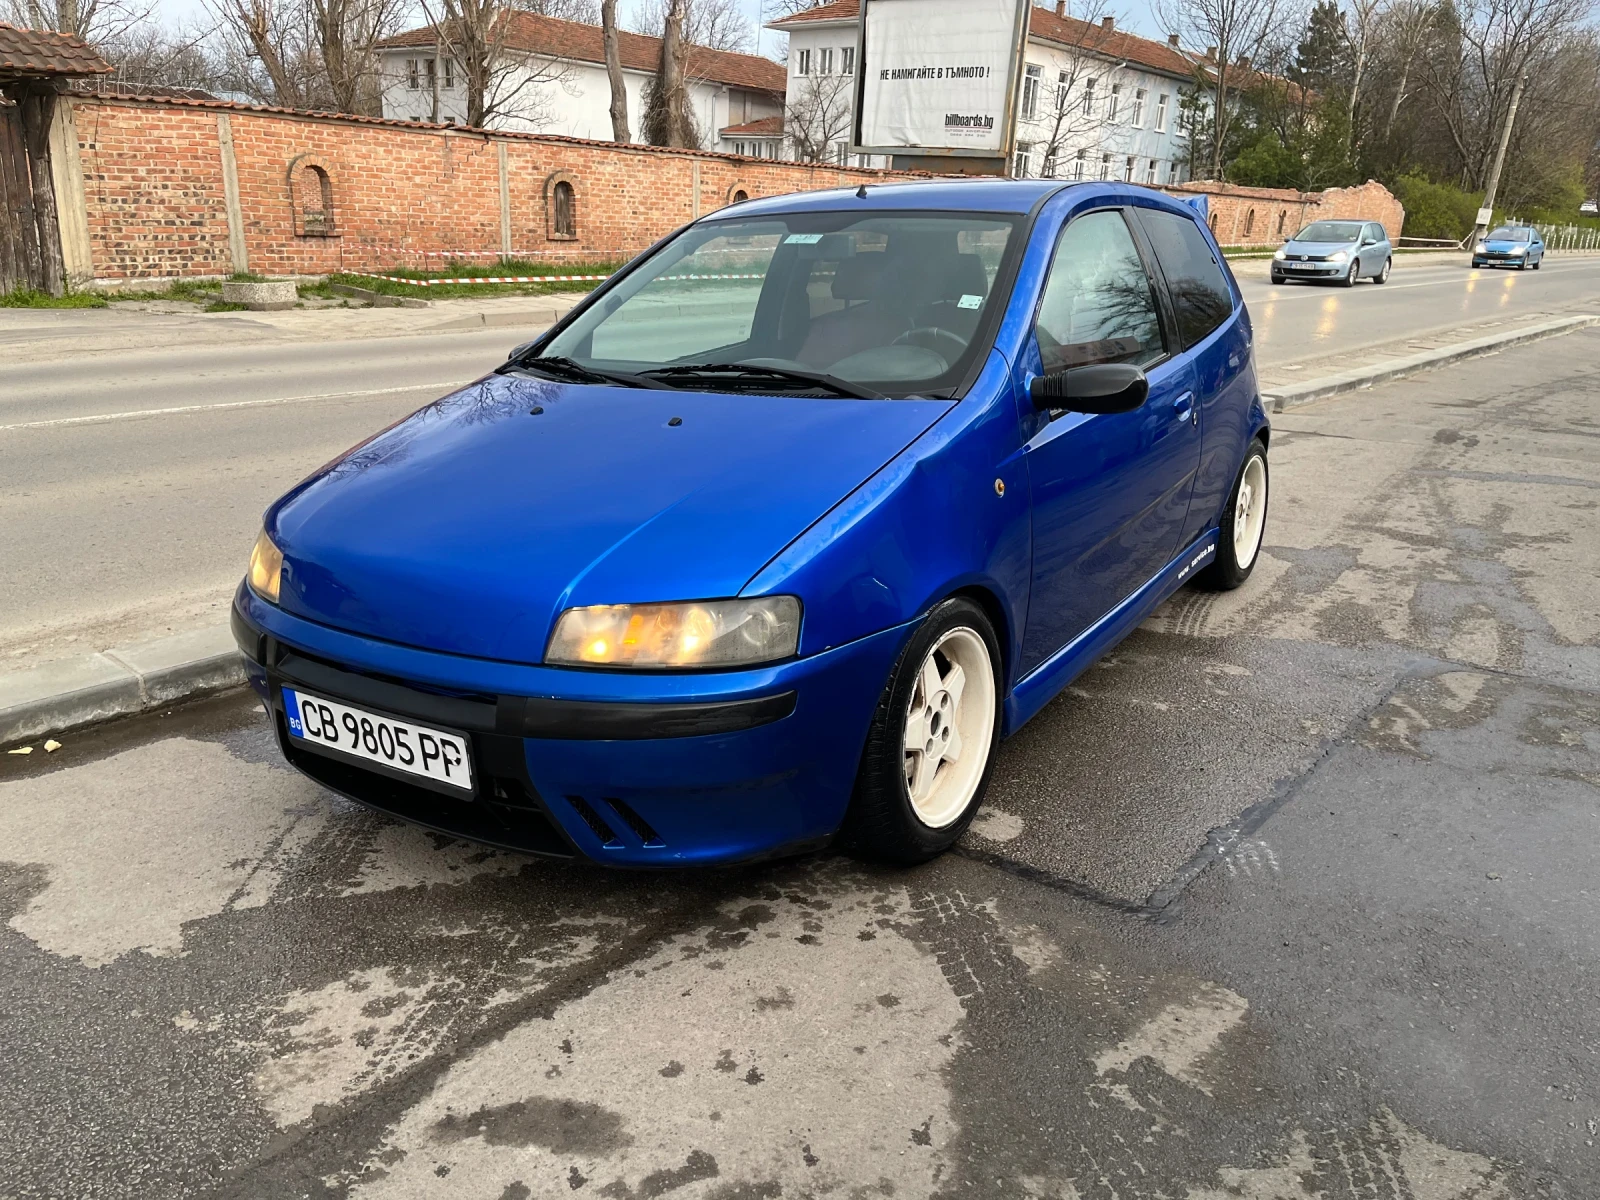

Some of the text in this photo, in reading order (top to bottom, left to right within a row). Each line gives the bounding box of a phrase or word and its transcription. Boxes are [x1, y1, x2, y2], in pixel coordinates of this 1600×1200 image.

[880, 69, 889, 80] НЕ
[891, 65, 936, 80] НАМИГАЙТЕ
[937, 68, 943, 79] В
[945, 67, 985, 79] ТЪМНОТО
[944, 113, 994, 129] billboards.bg
[290, 717, 301, 730] BG
